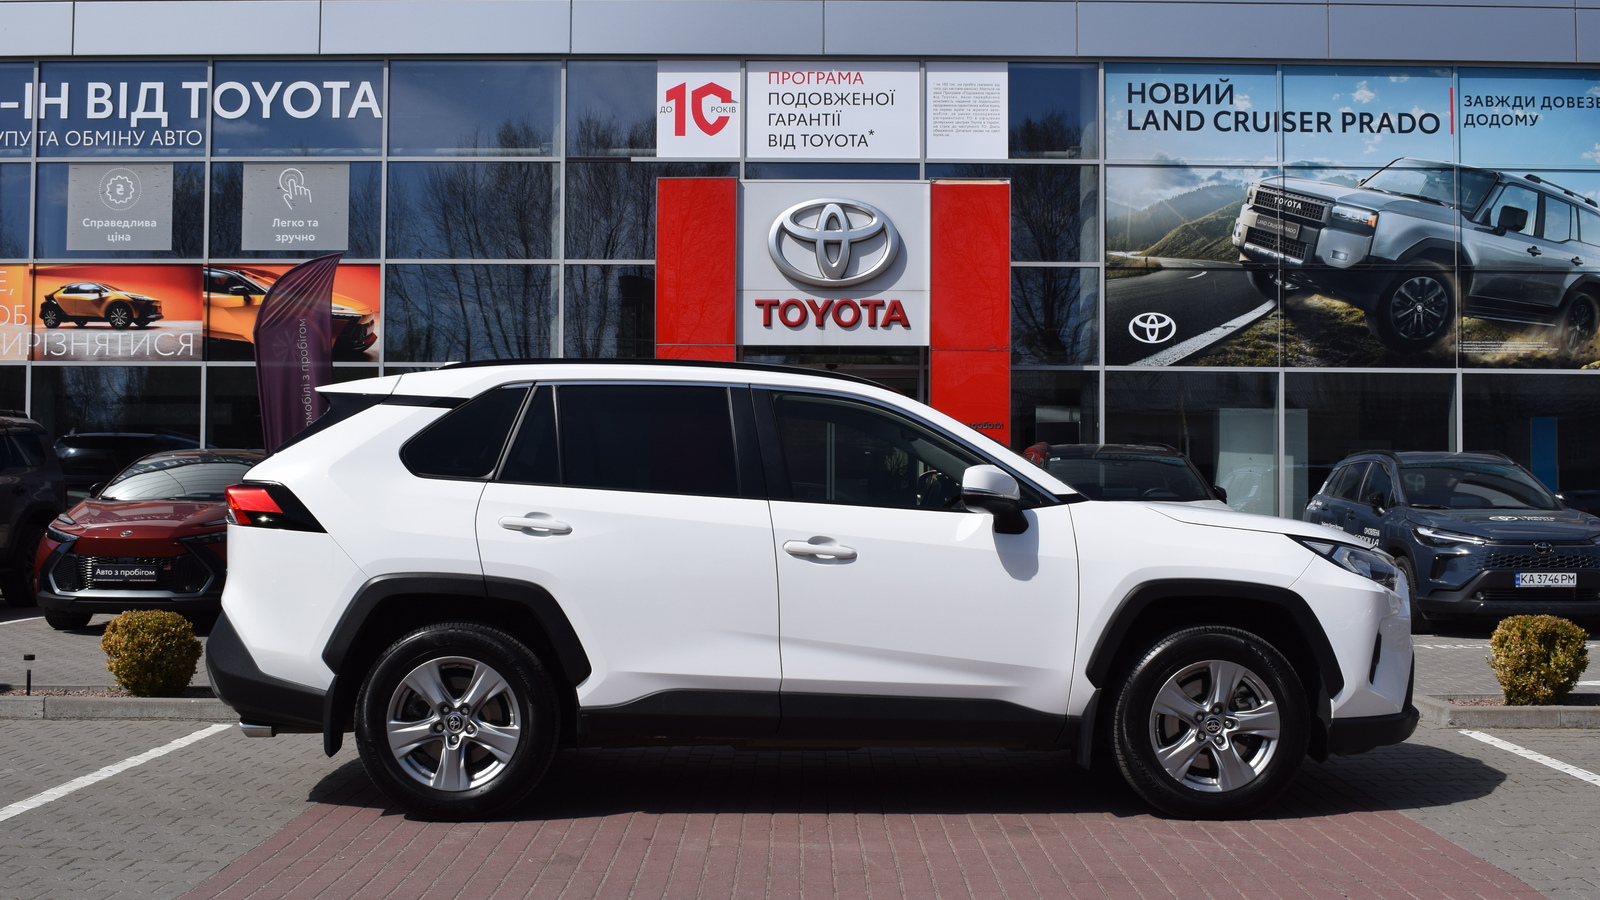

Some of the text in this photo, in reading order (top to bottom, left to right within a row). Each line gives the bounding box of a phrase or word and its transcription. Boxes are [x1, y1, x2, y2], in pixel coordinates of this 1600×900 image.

[767, 71, 864, 85] ПРОГРАМА
[767, 89, 896, 107] ПОДОВЖЕНОЇ
[1127, 77, 1235, 105] НОВИЙ
[86, 82, 169, 128] ВІД
[182, 81, 383, 120] TOYOTA
[1463, 94, 1536, 110] ЗАВЖДИ
[659, 106, 673, 115] ДО
[709, 106, 738, 114] РОКІВ
[767, 111, 842, 127] ГАРАНТІЇ
[1127, 110, 1442, 135] LAND CRUISER PRADO
[1463, 112, 1539, 126] ДОДОМУ
[37, 130, 59, 147] ТА
[65, 130, 146, 147] ОБМІНУ
[151, 130, 203, 147] АВТО
[767, 133, 797, 150] ВІД
[1274, 197, 1302, 210] TOYOTA
[82, 217, 157, 230] Справедлива
[271, 217, 319, 229] Легко та
[107, 232, 131, 244] ціна
[275, 233, 316, 244] зручно
[755, 298, 911, 329] TOYOTA
[297, 318, 311, 372] пробігом
[95, 568, 113, 576] Авто
[120, 568, 155, 577] пробігом
[1520, 574, 1576, 584] KA 3746 PM
